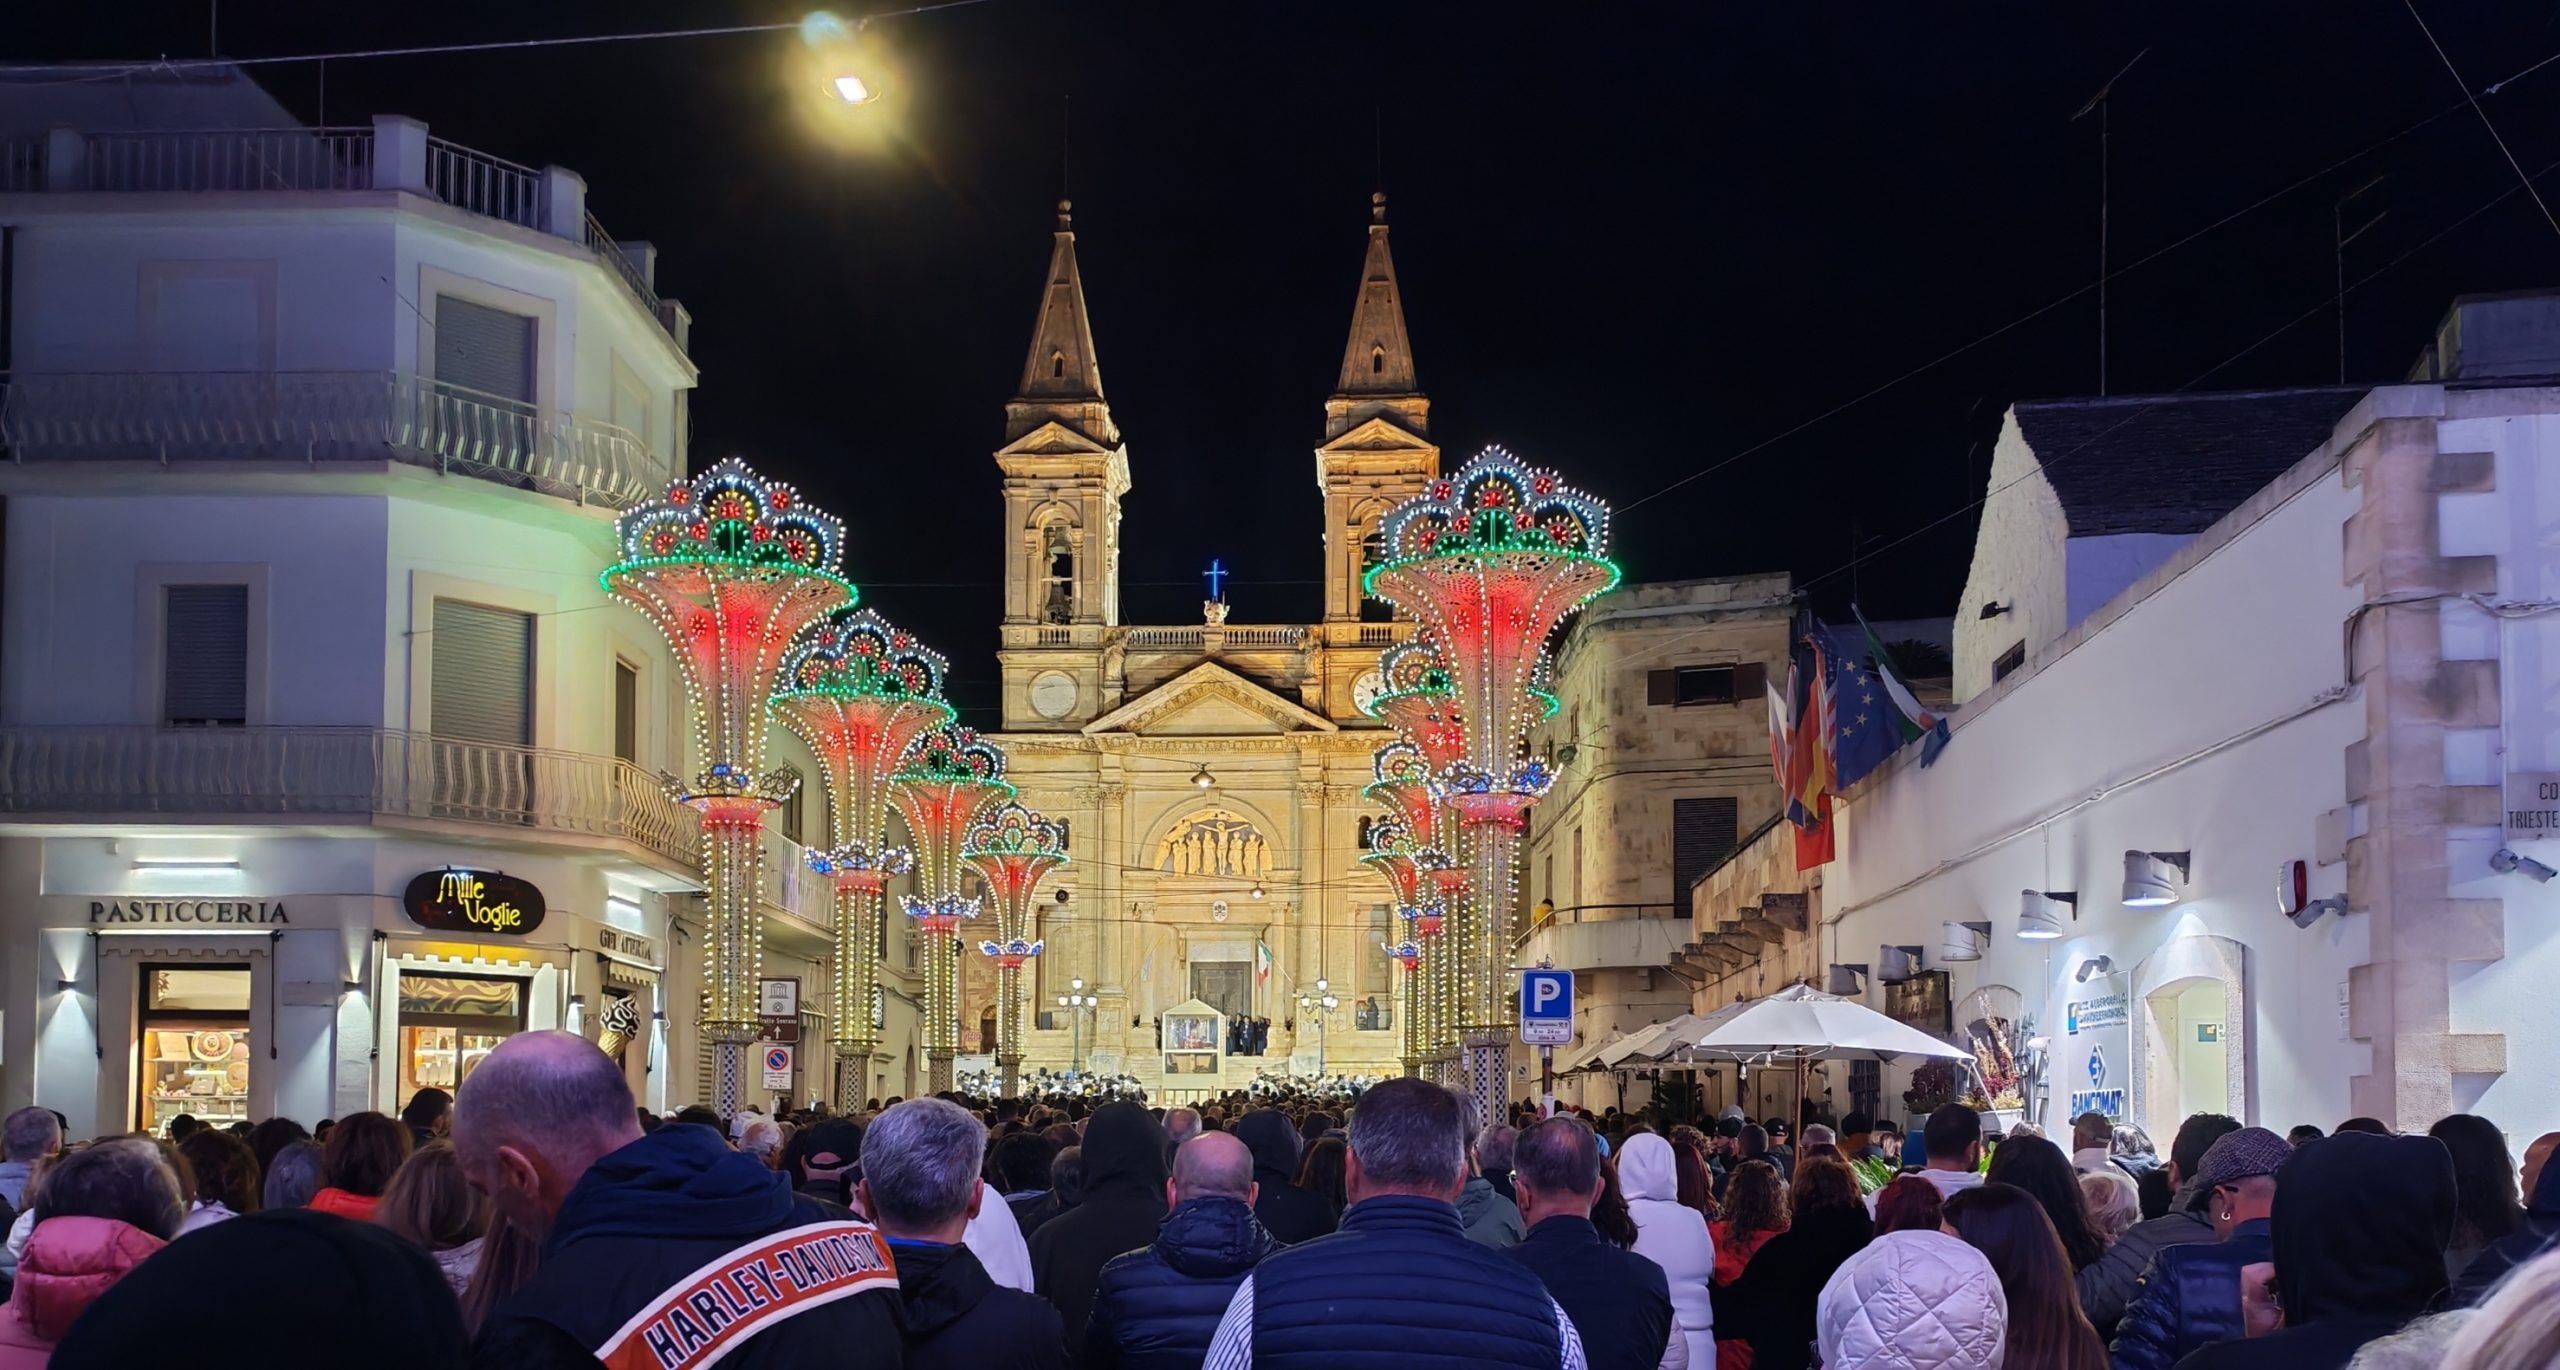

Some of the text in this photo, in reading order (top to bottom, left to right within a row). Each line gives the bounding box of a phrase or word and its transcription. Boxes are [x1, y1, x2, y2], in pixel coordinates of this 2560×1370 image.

[2508, 810, 2559, 829] TRIESTE
[436, 873, 485, 905] Mille
[89, 901, 289, 923] PASTICCERIA
[463, 899, 521, 931] Voglie
[600, 929, 651, 961] GELATERIA
[1534, 978, 1561, 1013] P
[2072, 1090, 2122, 1116] BANCOMAT
[643, 1231, 887, 1370] HARLEY-DAVIDSON
